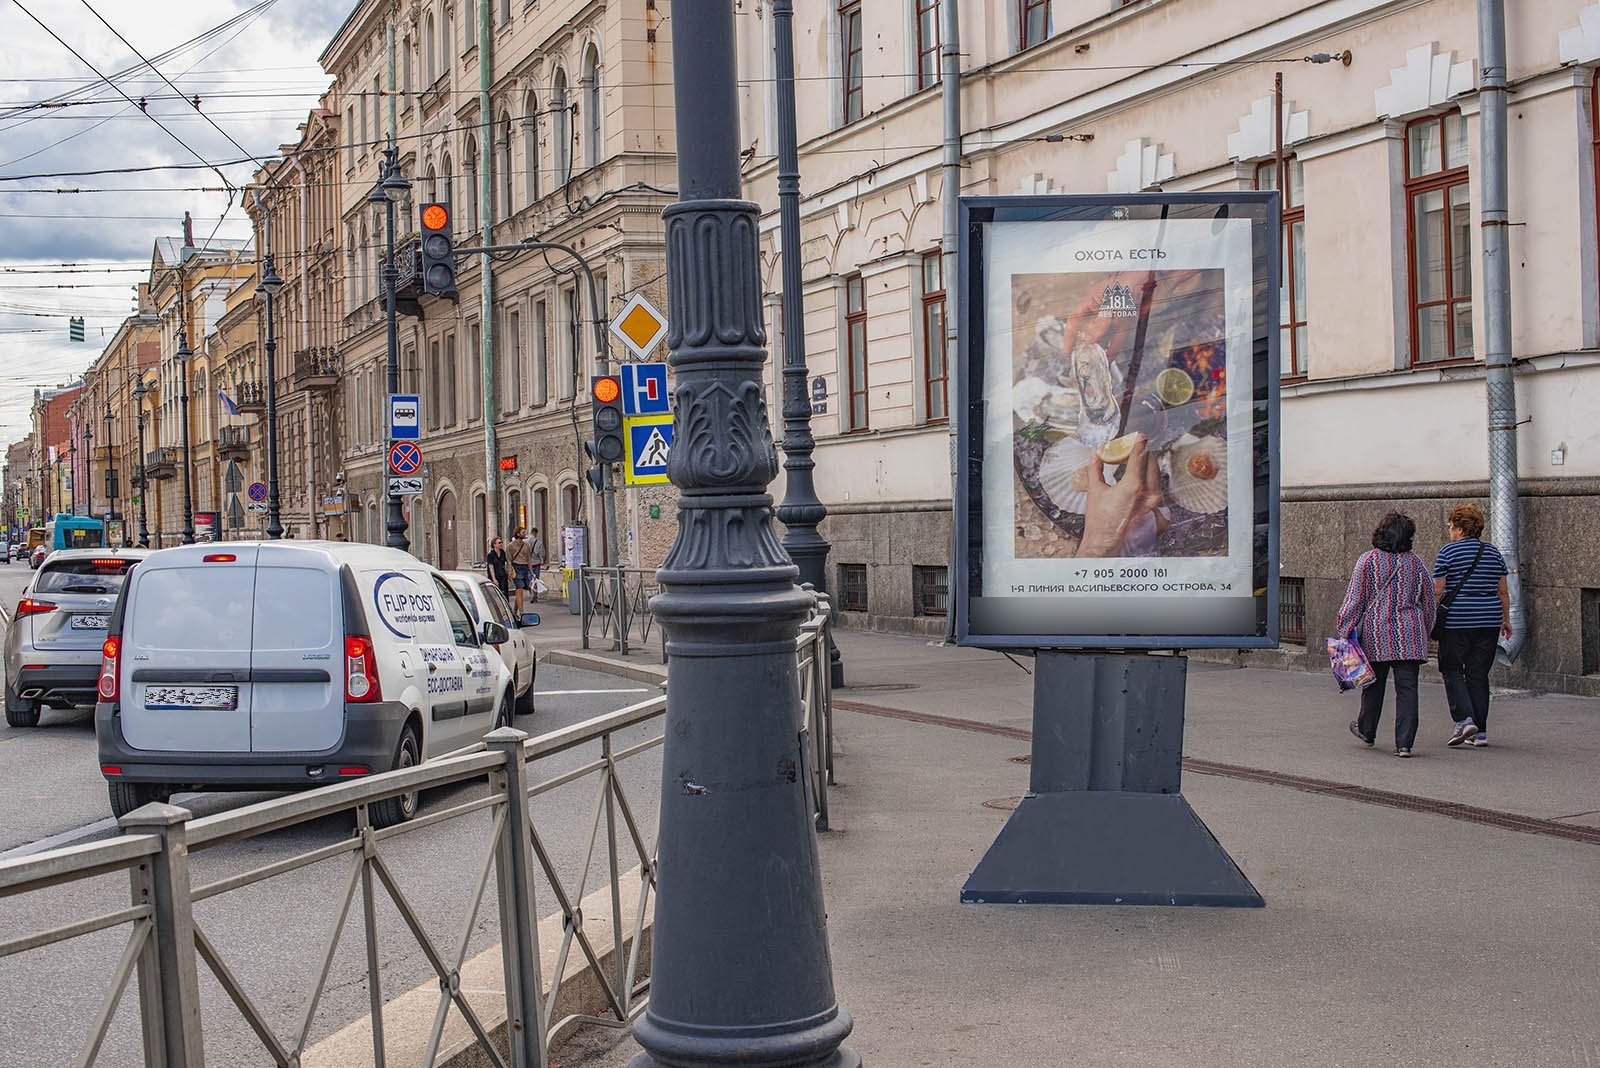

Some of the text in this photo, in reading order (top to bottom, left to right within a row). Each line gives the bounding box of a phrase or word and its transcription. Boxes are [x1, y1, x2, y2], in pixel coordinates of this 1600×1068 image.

[1075, 248, 1167, 261] ОХОТА ЕСТЬ
[1074, 568, 1168, 579] +7 905 2000 181
[1011, 582, 1232, 593] 1-Я ЛИНИЯ ВАСИЛЬЕВСКОГО ОСТРОВА, 34
[383, 594, 435, 612] FLIP POST
